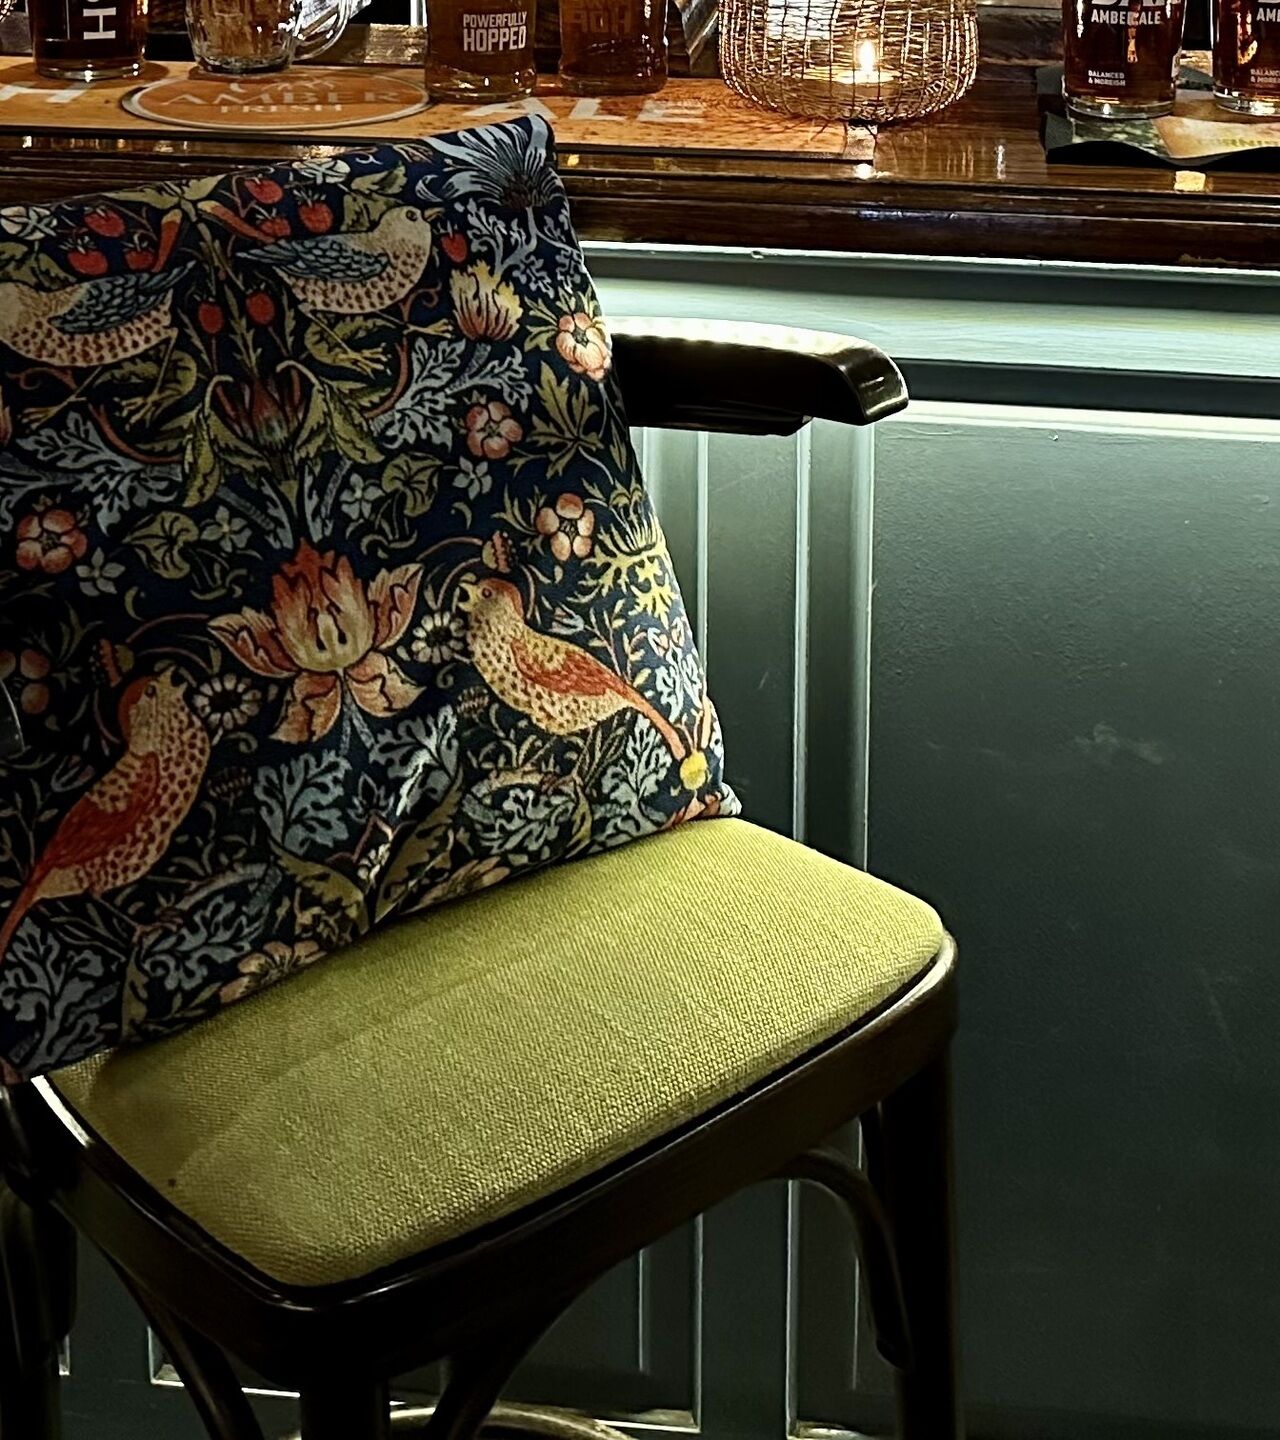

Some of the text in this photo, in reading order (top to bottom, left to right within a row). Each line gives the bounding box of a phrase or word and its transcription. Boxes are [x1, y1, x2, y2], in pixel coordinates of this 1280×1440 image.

[463, 11, 528, 28] POWERFULLY
[463, 27, 527, 53] HOPPED
[1088, 69, 1125, 80] BALANCED
[1094, 77, 1126, 87] MOREISH
[161, 90, 404, 107] AMBER
[220, 103, 343, 114] FRESH
[462, 97, 705, 125] ALE
